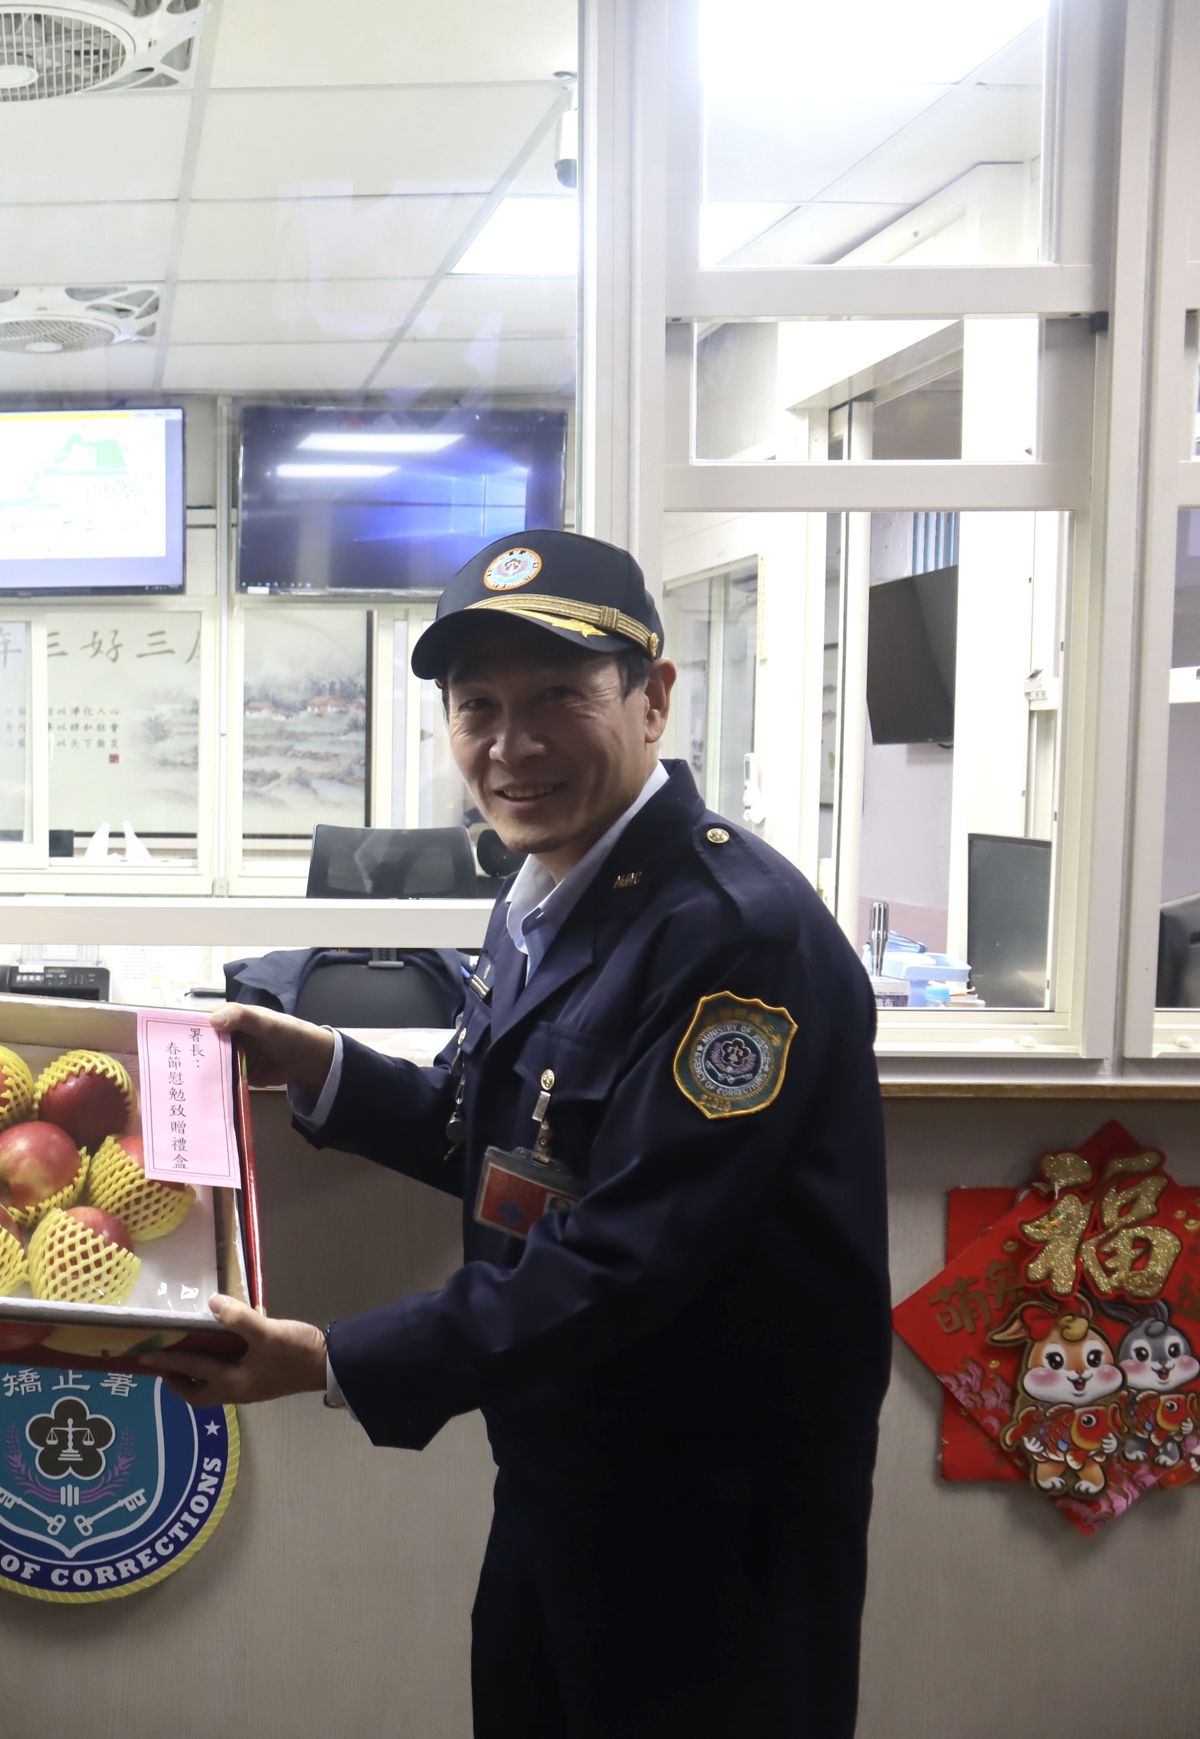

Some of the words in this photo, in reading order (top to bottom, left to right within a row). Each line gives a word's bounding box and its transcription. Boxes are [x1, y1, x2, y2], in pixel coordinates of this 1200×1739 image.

[701, 1025, 738, 1044] MINISTRY
[166, 1041, 189, 1169] 春節慰勉致贈禮盒
[1020, 1151, 1182, 1299] 福
[0, 1554, 41, 1580] OF
[50, 1457, 222, 1586] CORRECTIONS
